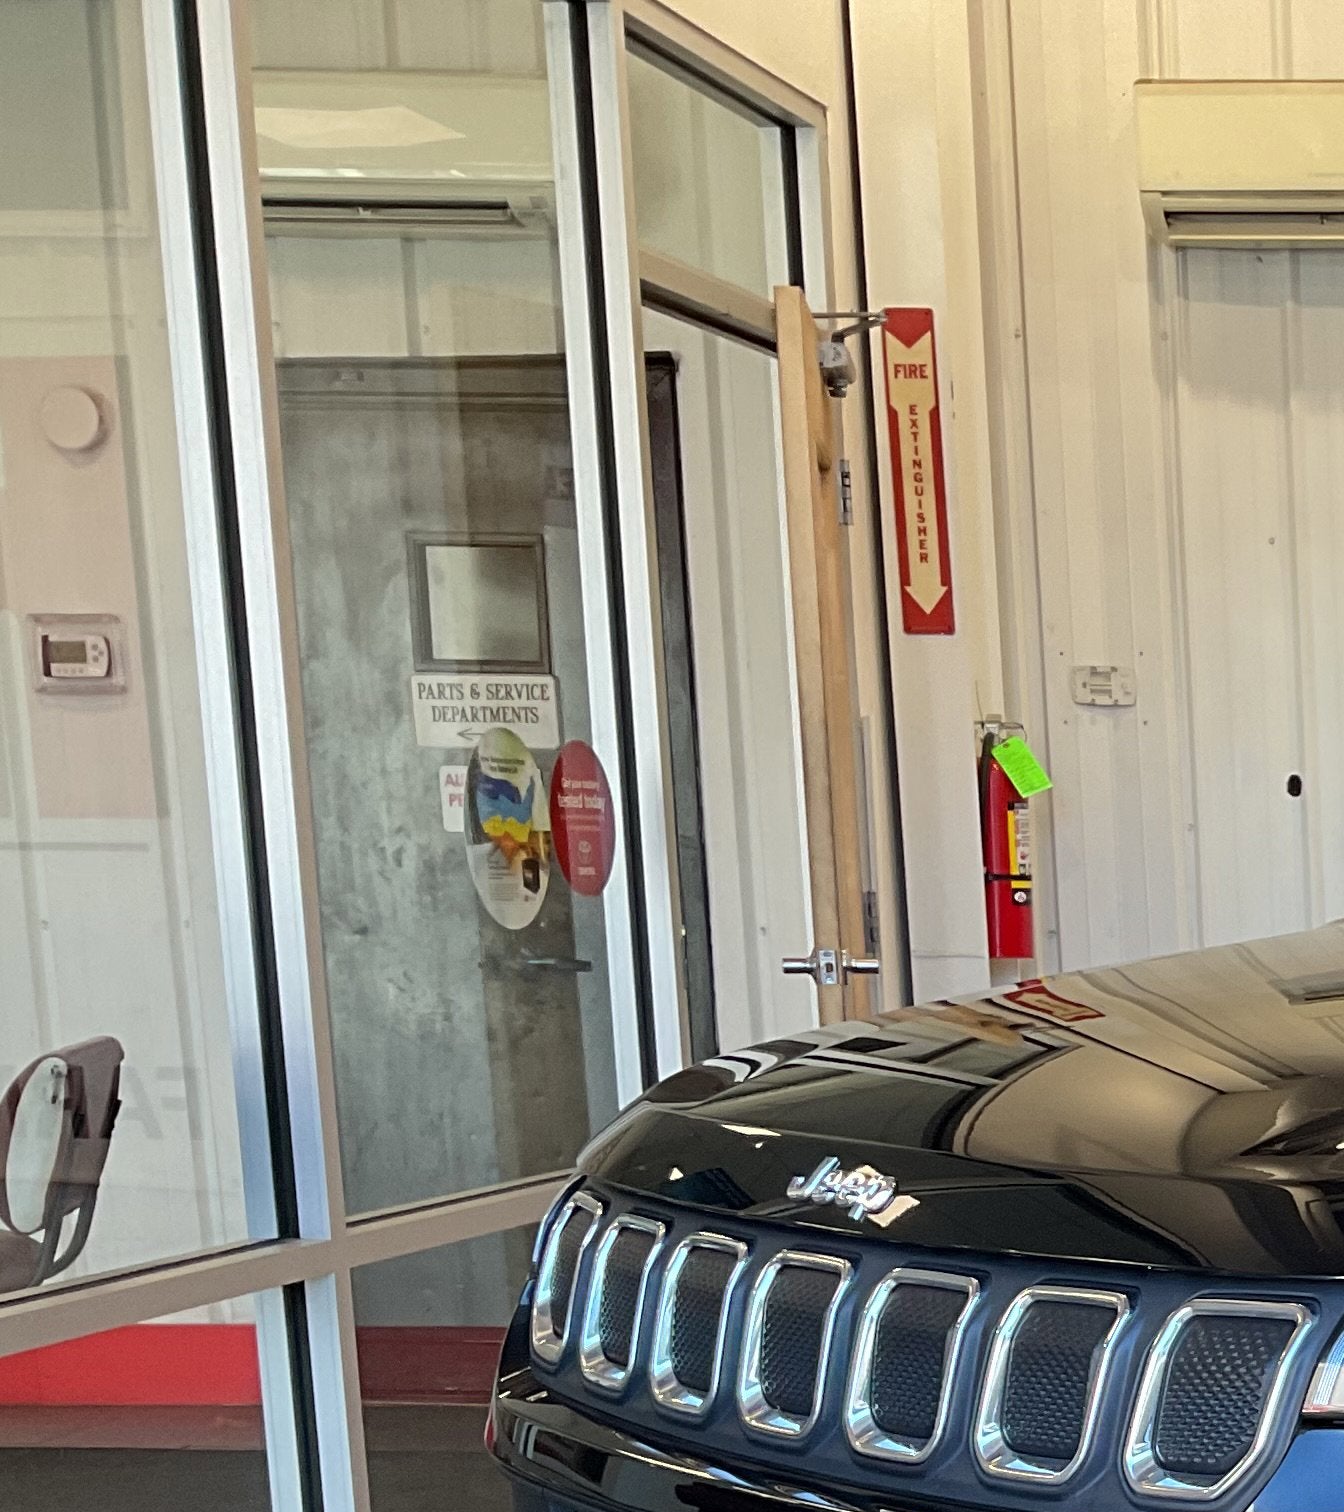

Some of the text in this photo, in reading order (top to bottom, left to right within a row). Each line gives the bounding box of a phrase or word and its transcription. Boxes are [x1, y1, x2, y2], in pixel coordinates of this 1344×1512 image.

[893, 363, 929, 379] FIRE
[908, 404, 929, 564] EXTINGUISHER
[417, 682, 550, 701] PARTS & SERVICE
[431, 705, 540, 724] DEPARTMENTS
[786, 1156, 897, 1222] Jeep
